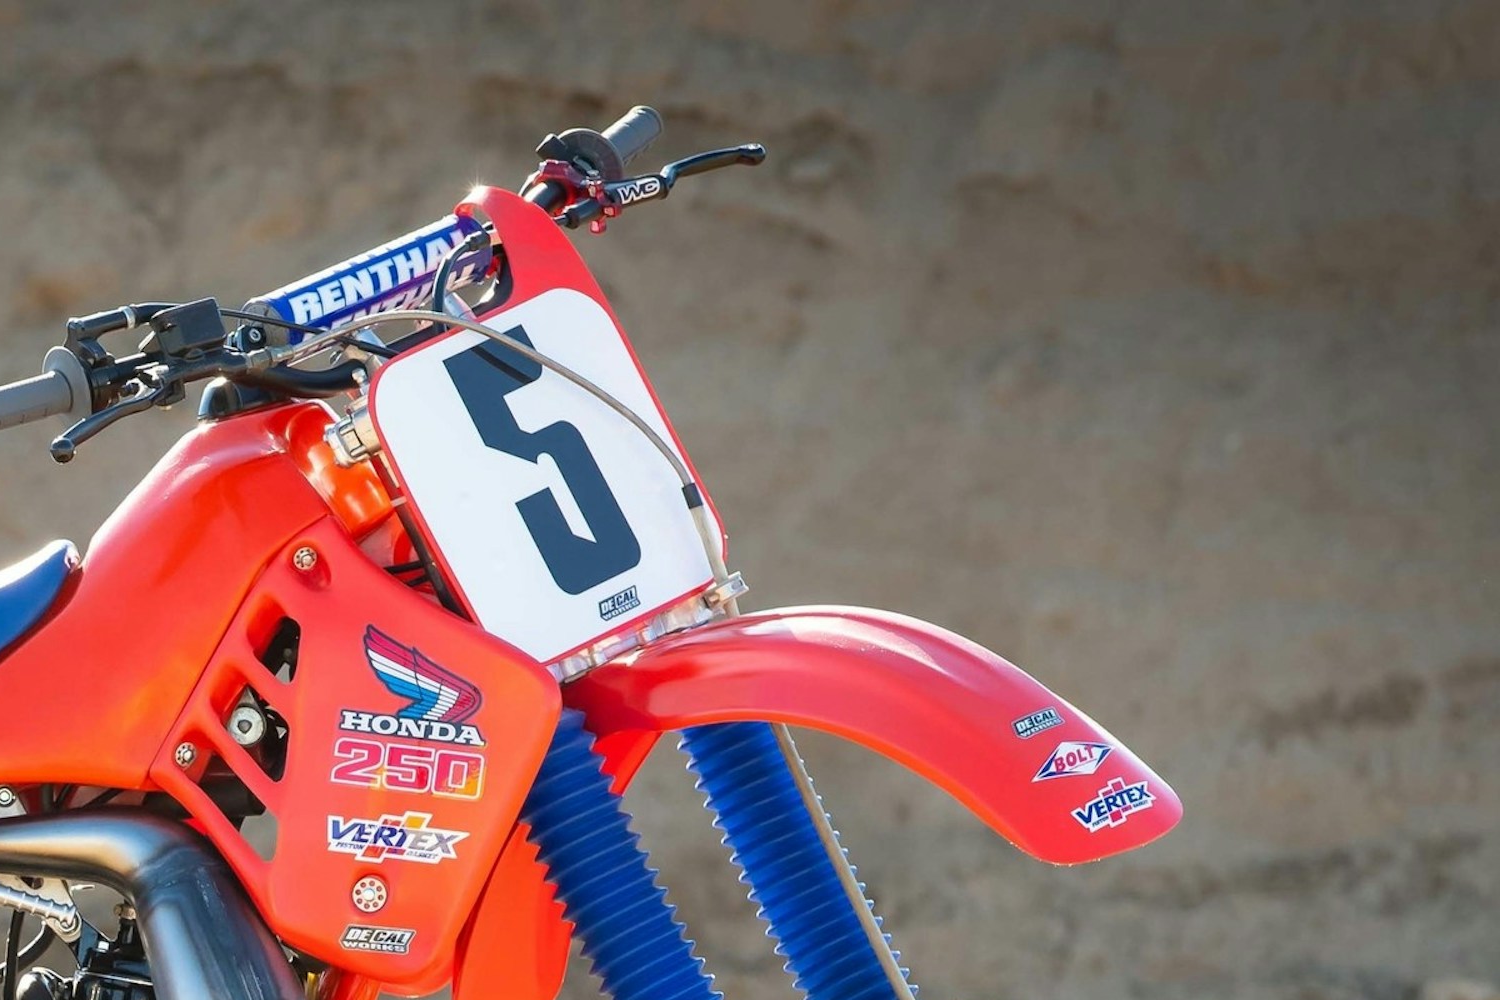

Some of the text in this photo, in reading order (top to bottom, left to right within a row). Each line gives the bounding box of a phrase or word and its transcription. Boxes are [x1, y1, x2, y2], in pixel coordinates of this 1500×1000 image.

[443, 325, 641, 594] 5
[602, 589, 635, 614] DECAL
[341, 711, 485, 745] HONDA
[1016, 710, 1056, 732] DECAL
[331, 738, 486, 800] 250
[1054, 744, 1094, 772] BOLT
[1075, 785, 1151, 824] VERTEX
[332, 820, 458, 855] VERTEX
[343, 941, 405, 952] WORKS
[346, 928, 412, 946] DECAL
